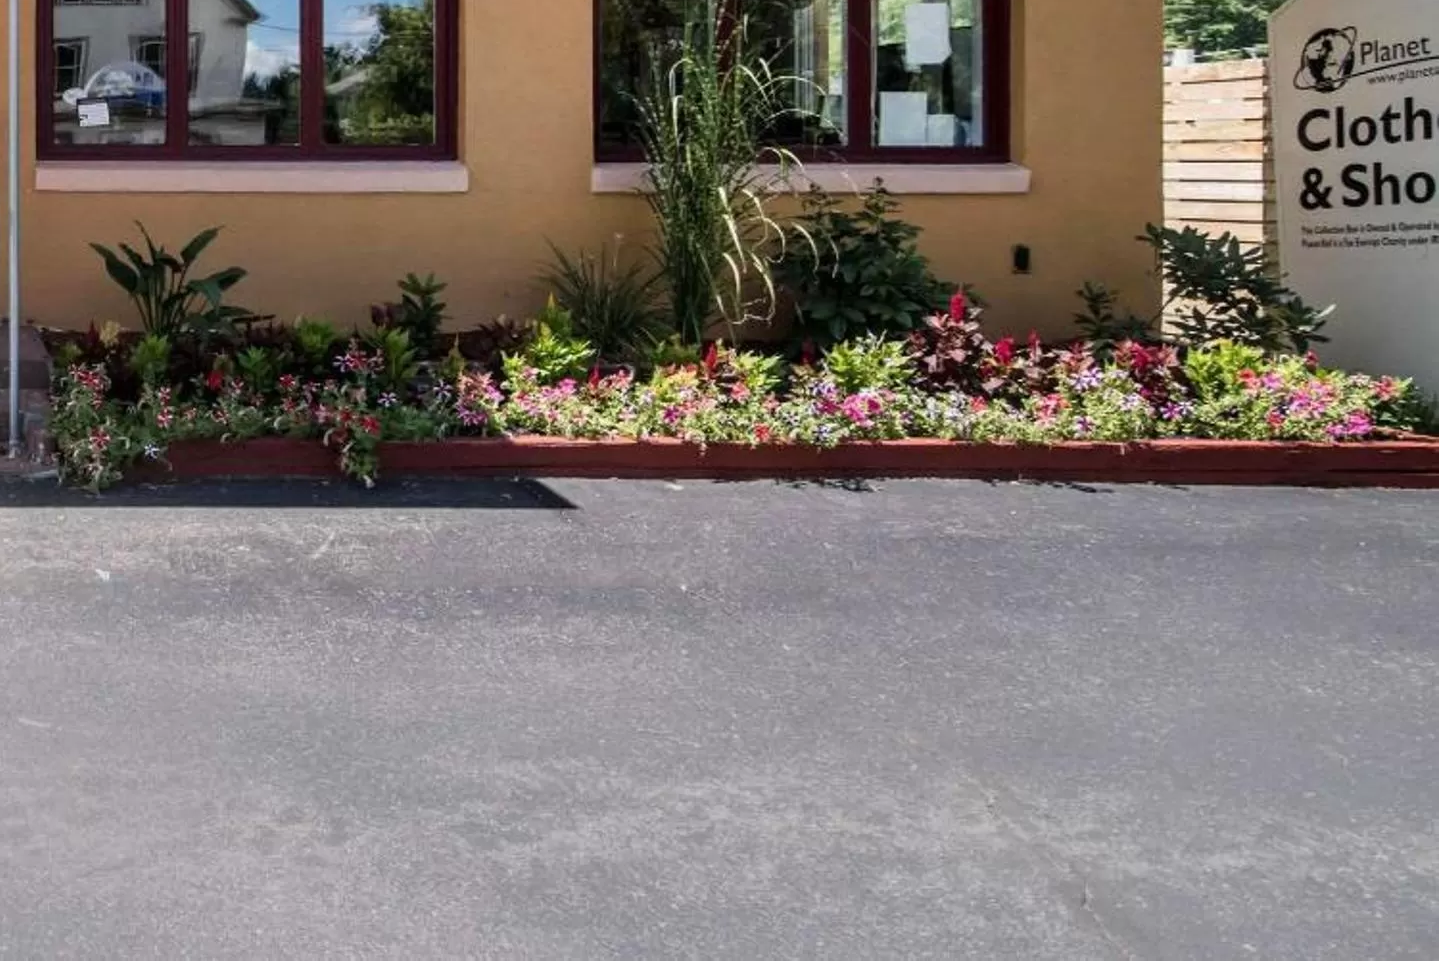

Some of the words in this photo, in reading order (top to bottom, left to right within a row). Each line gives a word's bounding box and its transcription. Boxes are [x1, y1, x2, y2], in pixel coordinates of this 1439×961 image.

[1360, 38, 1431, 65] Planet
[1297, 97, 1439, 151] Cloth
[1299, 167, 1334, 210] &
[1341, 162, 1436, 208] Sho
